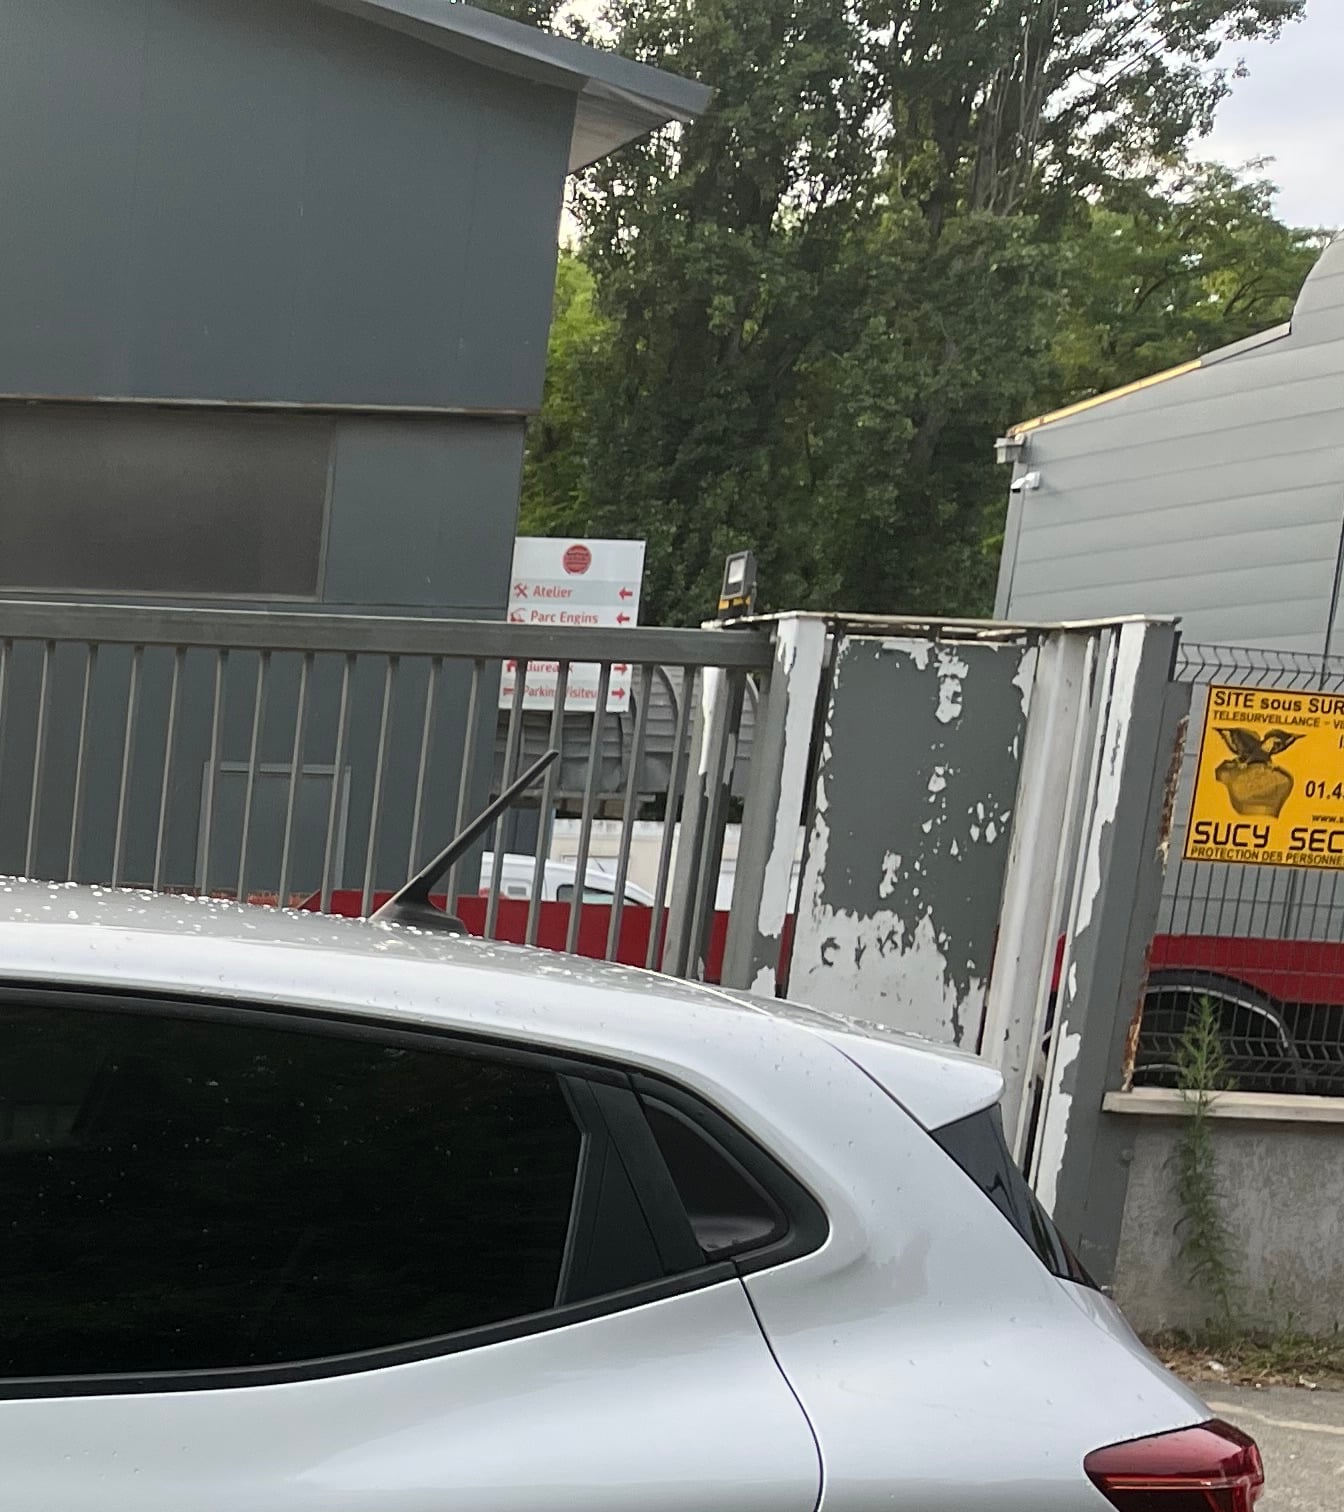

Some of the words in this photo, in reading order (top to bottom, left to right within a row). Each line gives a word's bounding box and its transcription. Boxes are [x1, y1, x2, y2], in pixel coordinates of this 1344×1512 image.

[532, 586, 572, 599] Atelier
[530, 609, 557, 624] Parc
[559, 612, 599, 625] Engins
[1213, 690, 1255, 709] SITE
[1260, 697, 1302, 712] sous
[1193, 821, 1270, 848] SUCY
[1289, 827, 1344, 853] SEC
[1191, 847, 1258, 860] PROTECTION
[1261, 850, 1283, 862] DES
